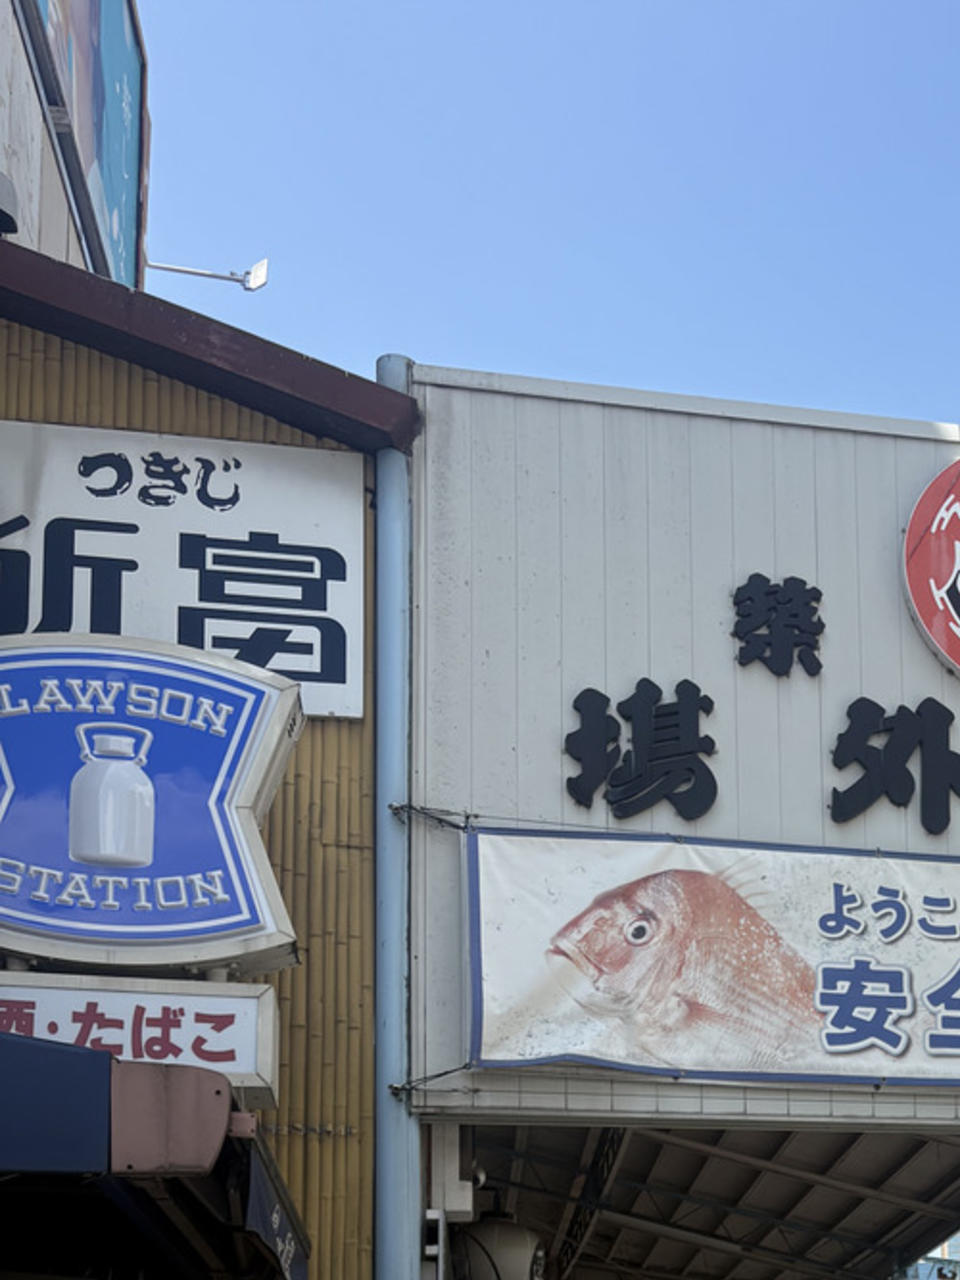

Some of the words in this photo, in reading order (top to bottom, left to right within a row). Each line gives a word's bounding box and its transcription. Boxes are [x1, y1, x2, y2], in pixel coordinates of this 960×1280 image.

[78, 452, 242, 511] つきじ
[0, 679, 233, 737] LAWSON
[0, 858, 231, 911] STATION
